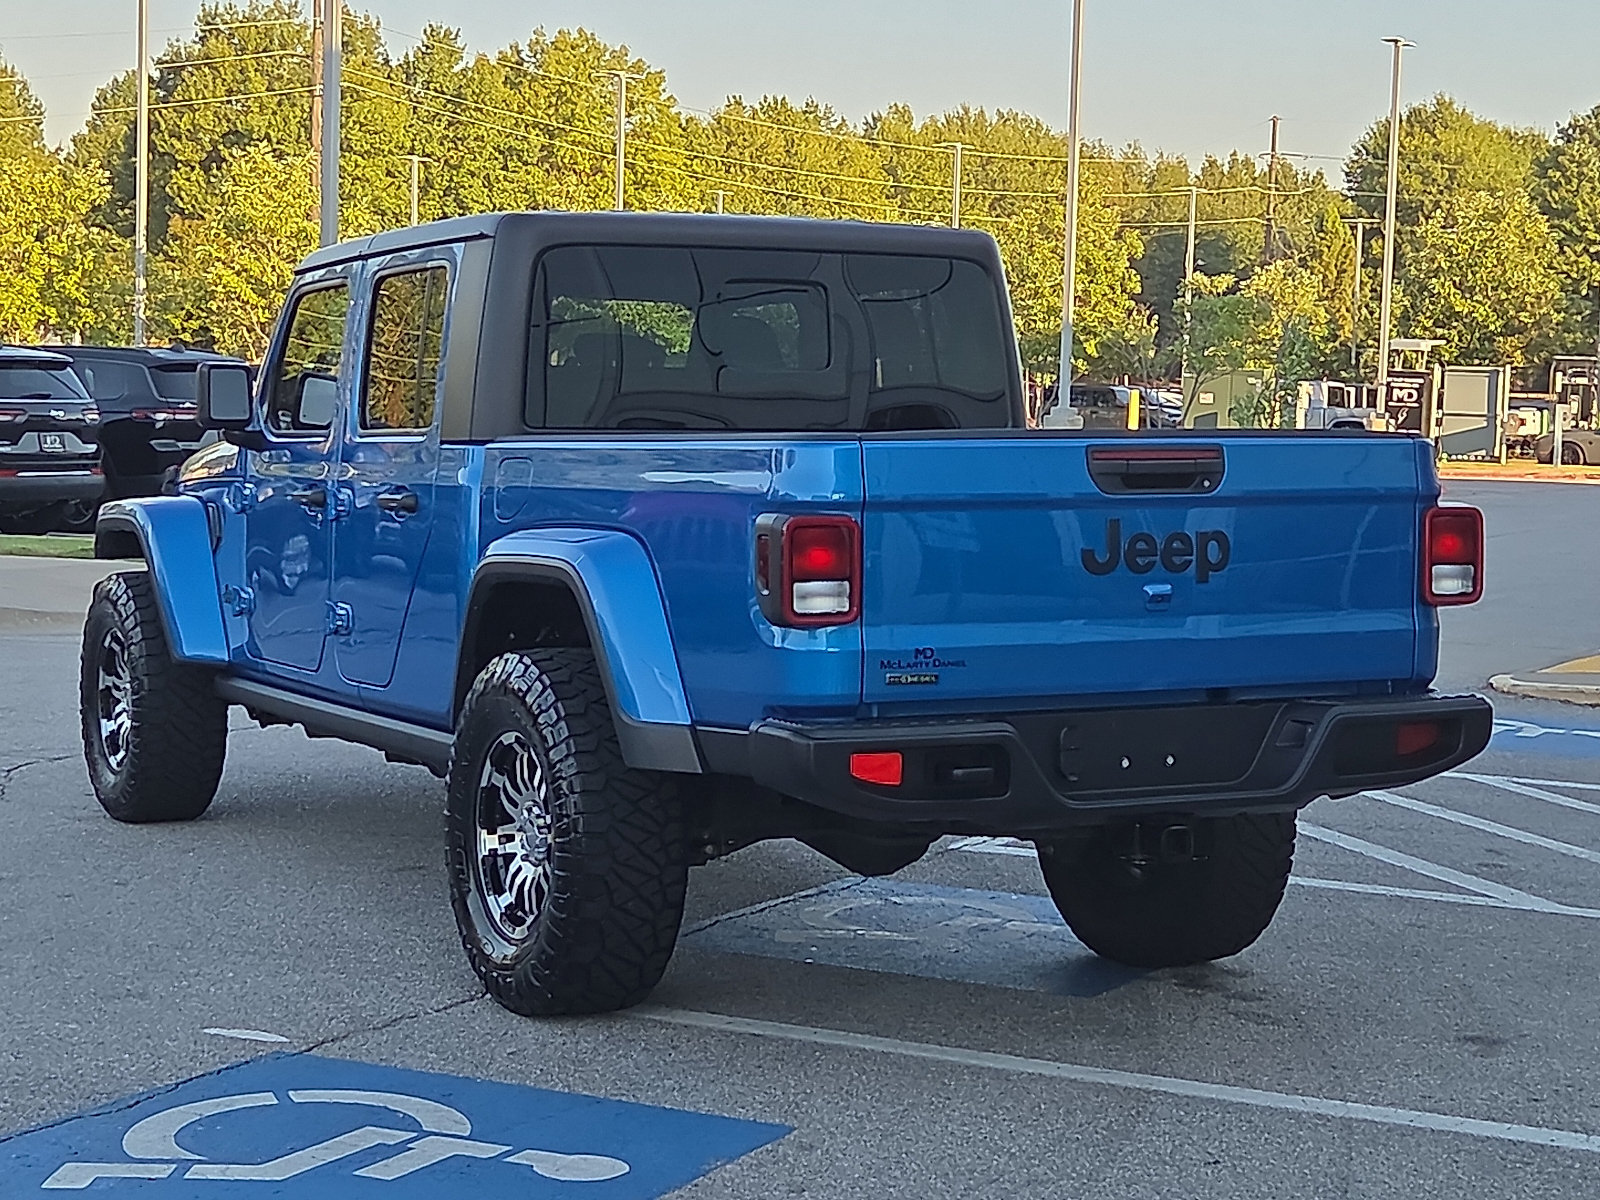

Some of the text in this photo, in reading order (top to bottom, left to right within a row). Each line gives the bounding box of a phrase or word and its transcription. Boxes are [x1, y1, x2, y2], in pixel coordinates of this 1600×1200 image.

[1392, 387, 1419, 402] MD
[1081, 518, 1231, 584] Jeep
[914, 647, 935, 660] MD
